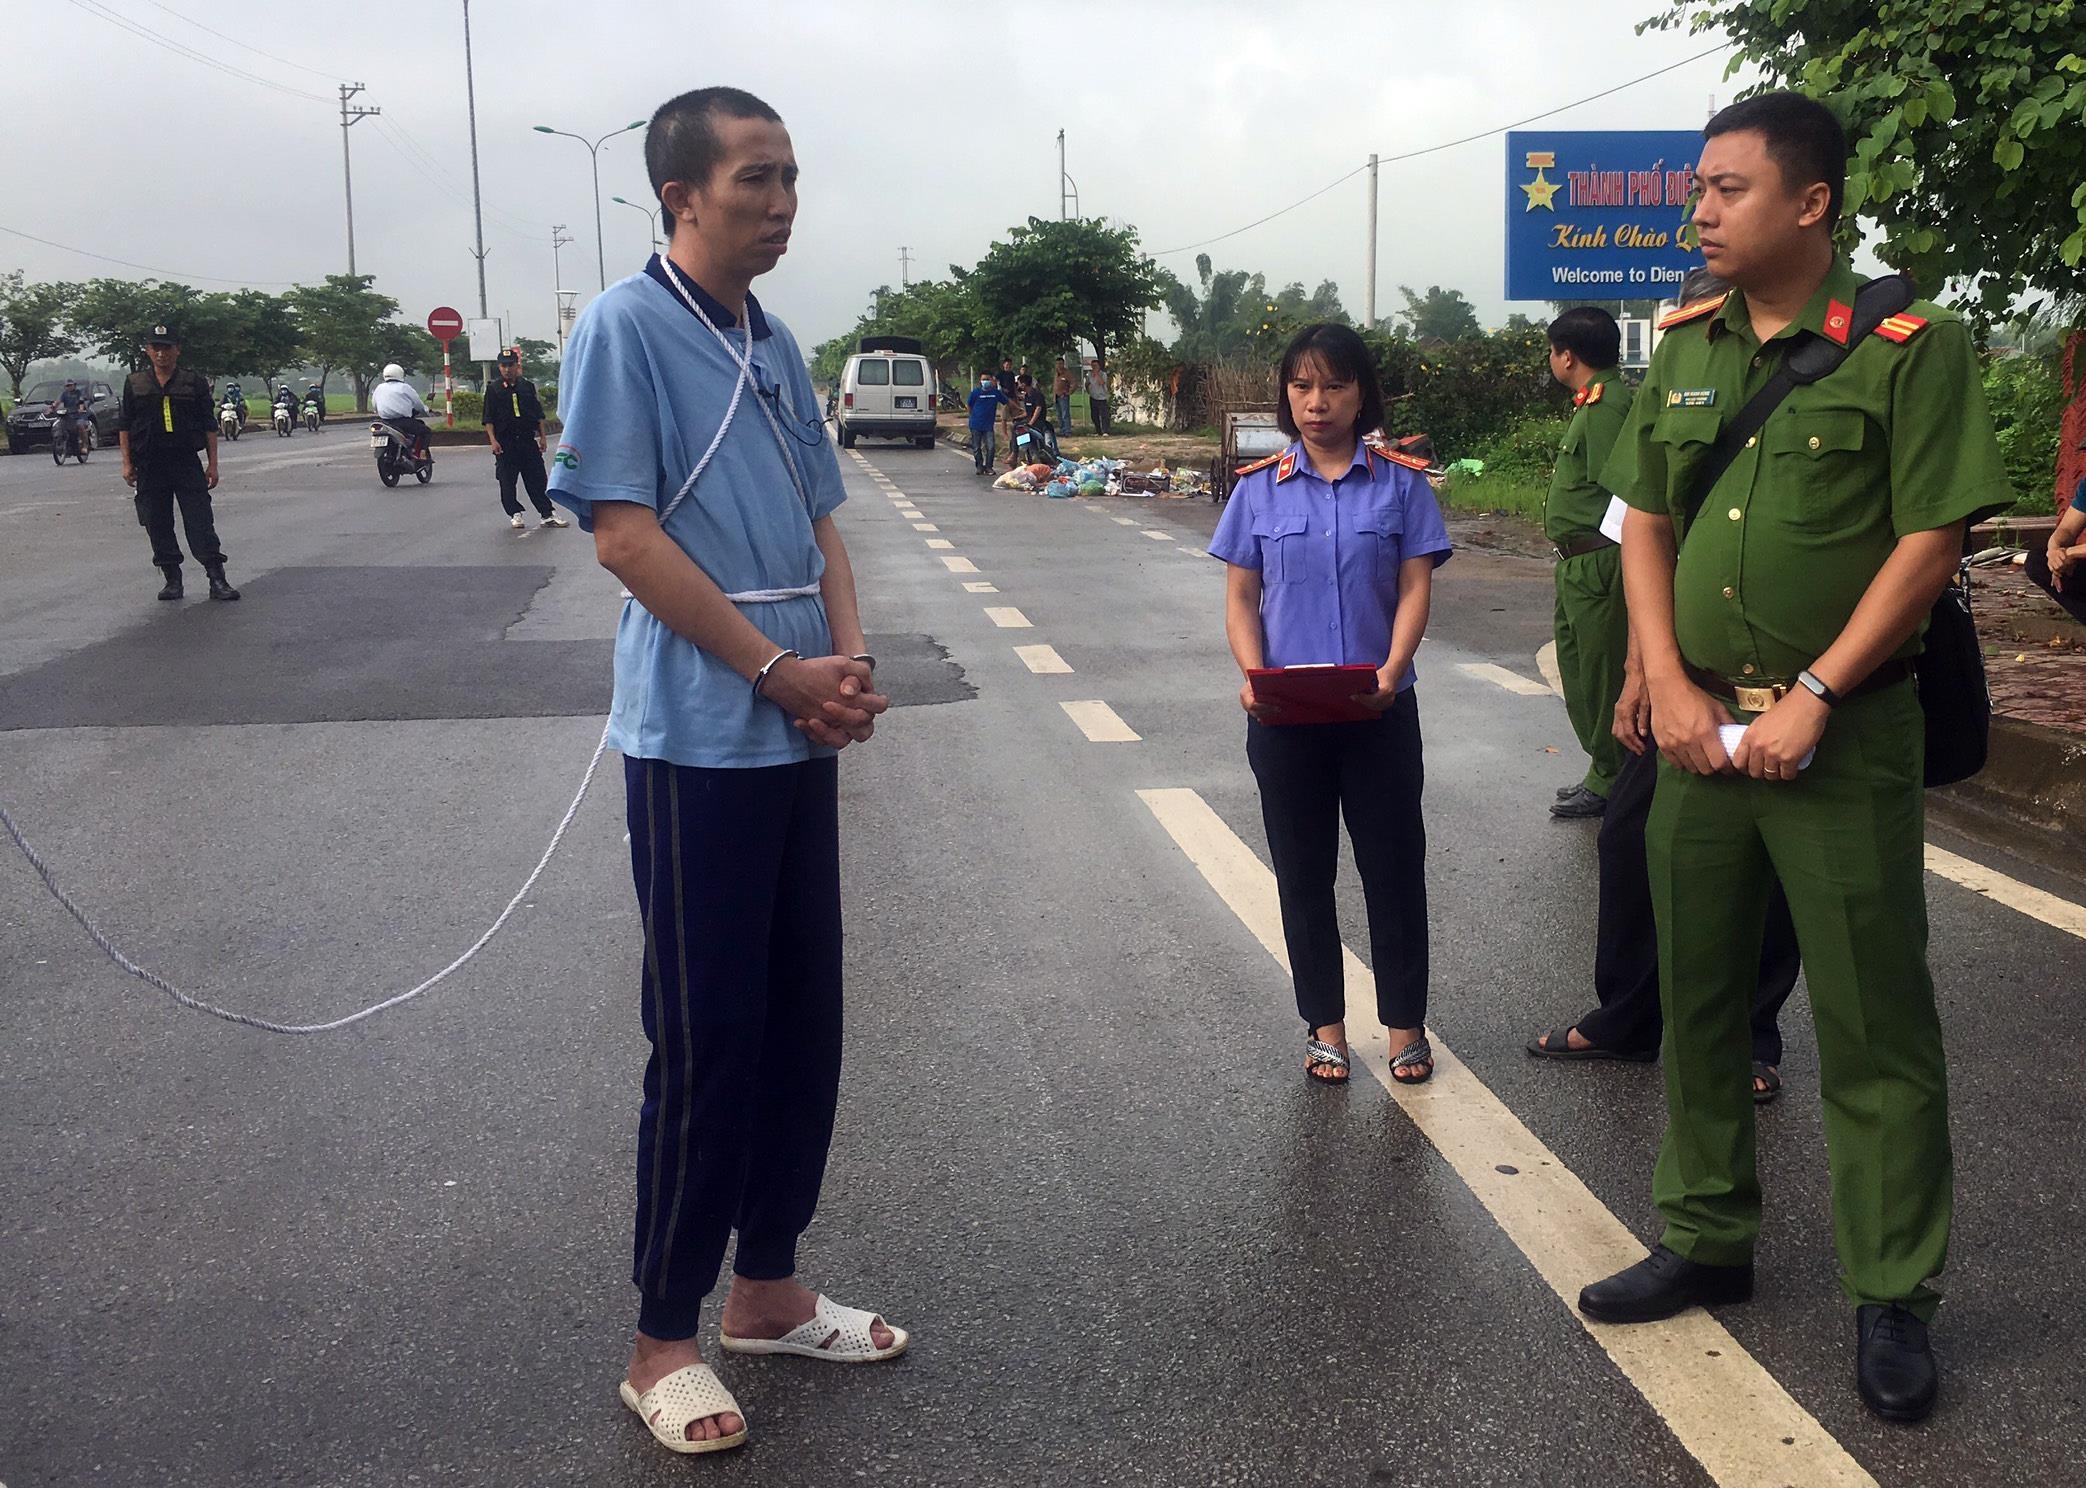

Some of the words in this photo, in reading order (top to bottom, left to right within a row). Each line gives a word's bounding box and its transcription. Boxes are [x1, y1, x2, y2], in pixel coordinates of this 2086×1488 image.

[1568, 163, 1624, 206] THÀNH
[1628, 158, 1664, 206] PHỐ
[1548, 223, 1608, 248] Kính
[1614, 223, 1668, 248] Chào
[1552, 267, 1623, 283] Welcome
[1629, 267, 1646, 283] to
[1651, 266, 1685, 283] Dien
